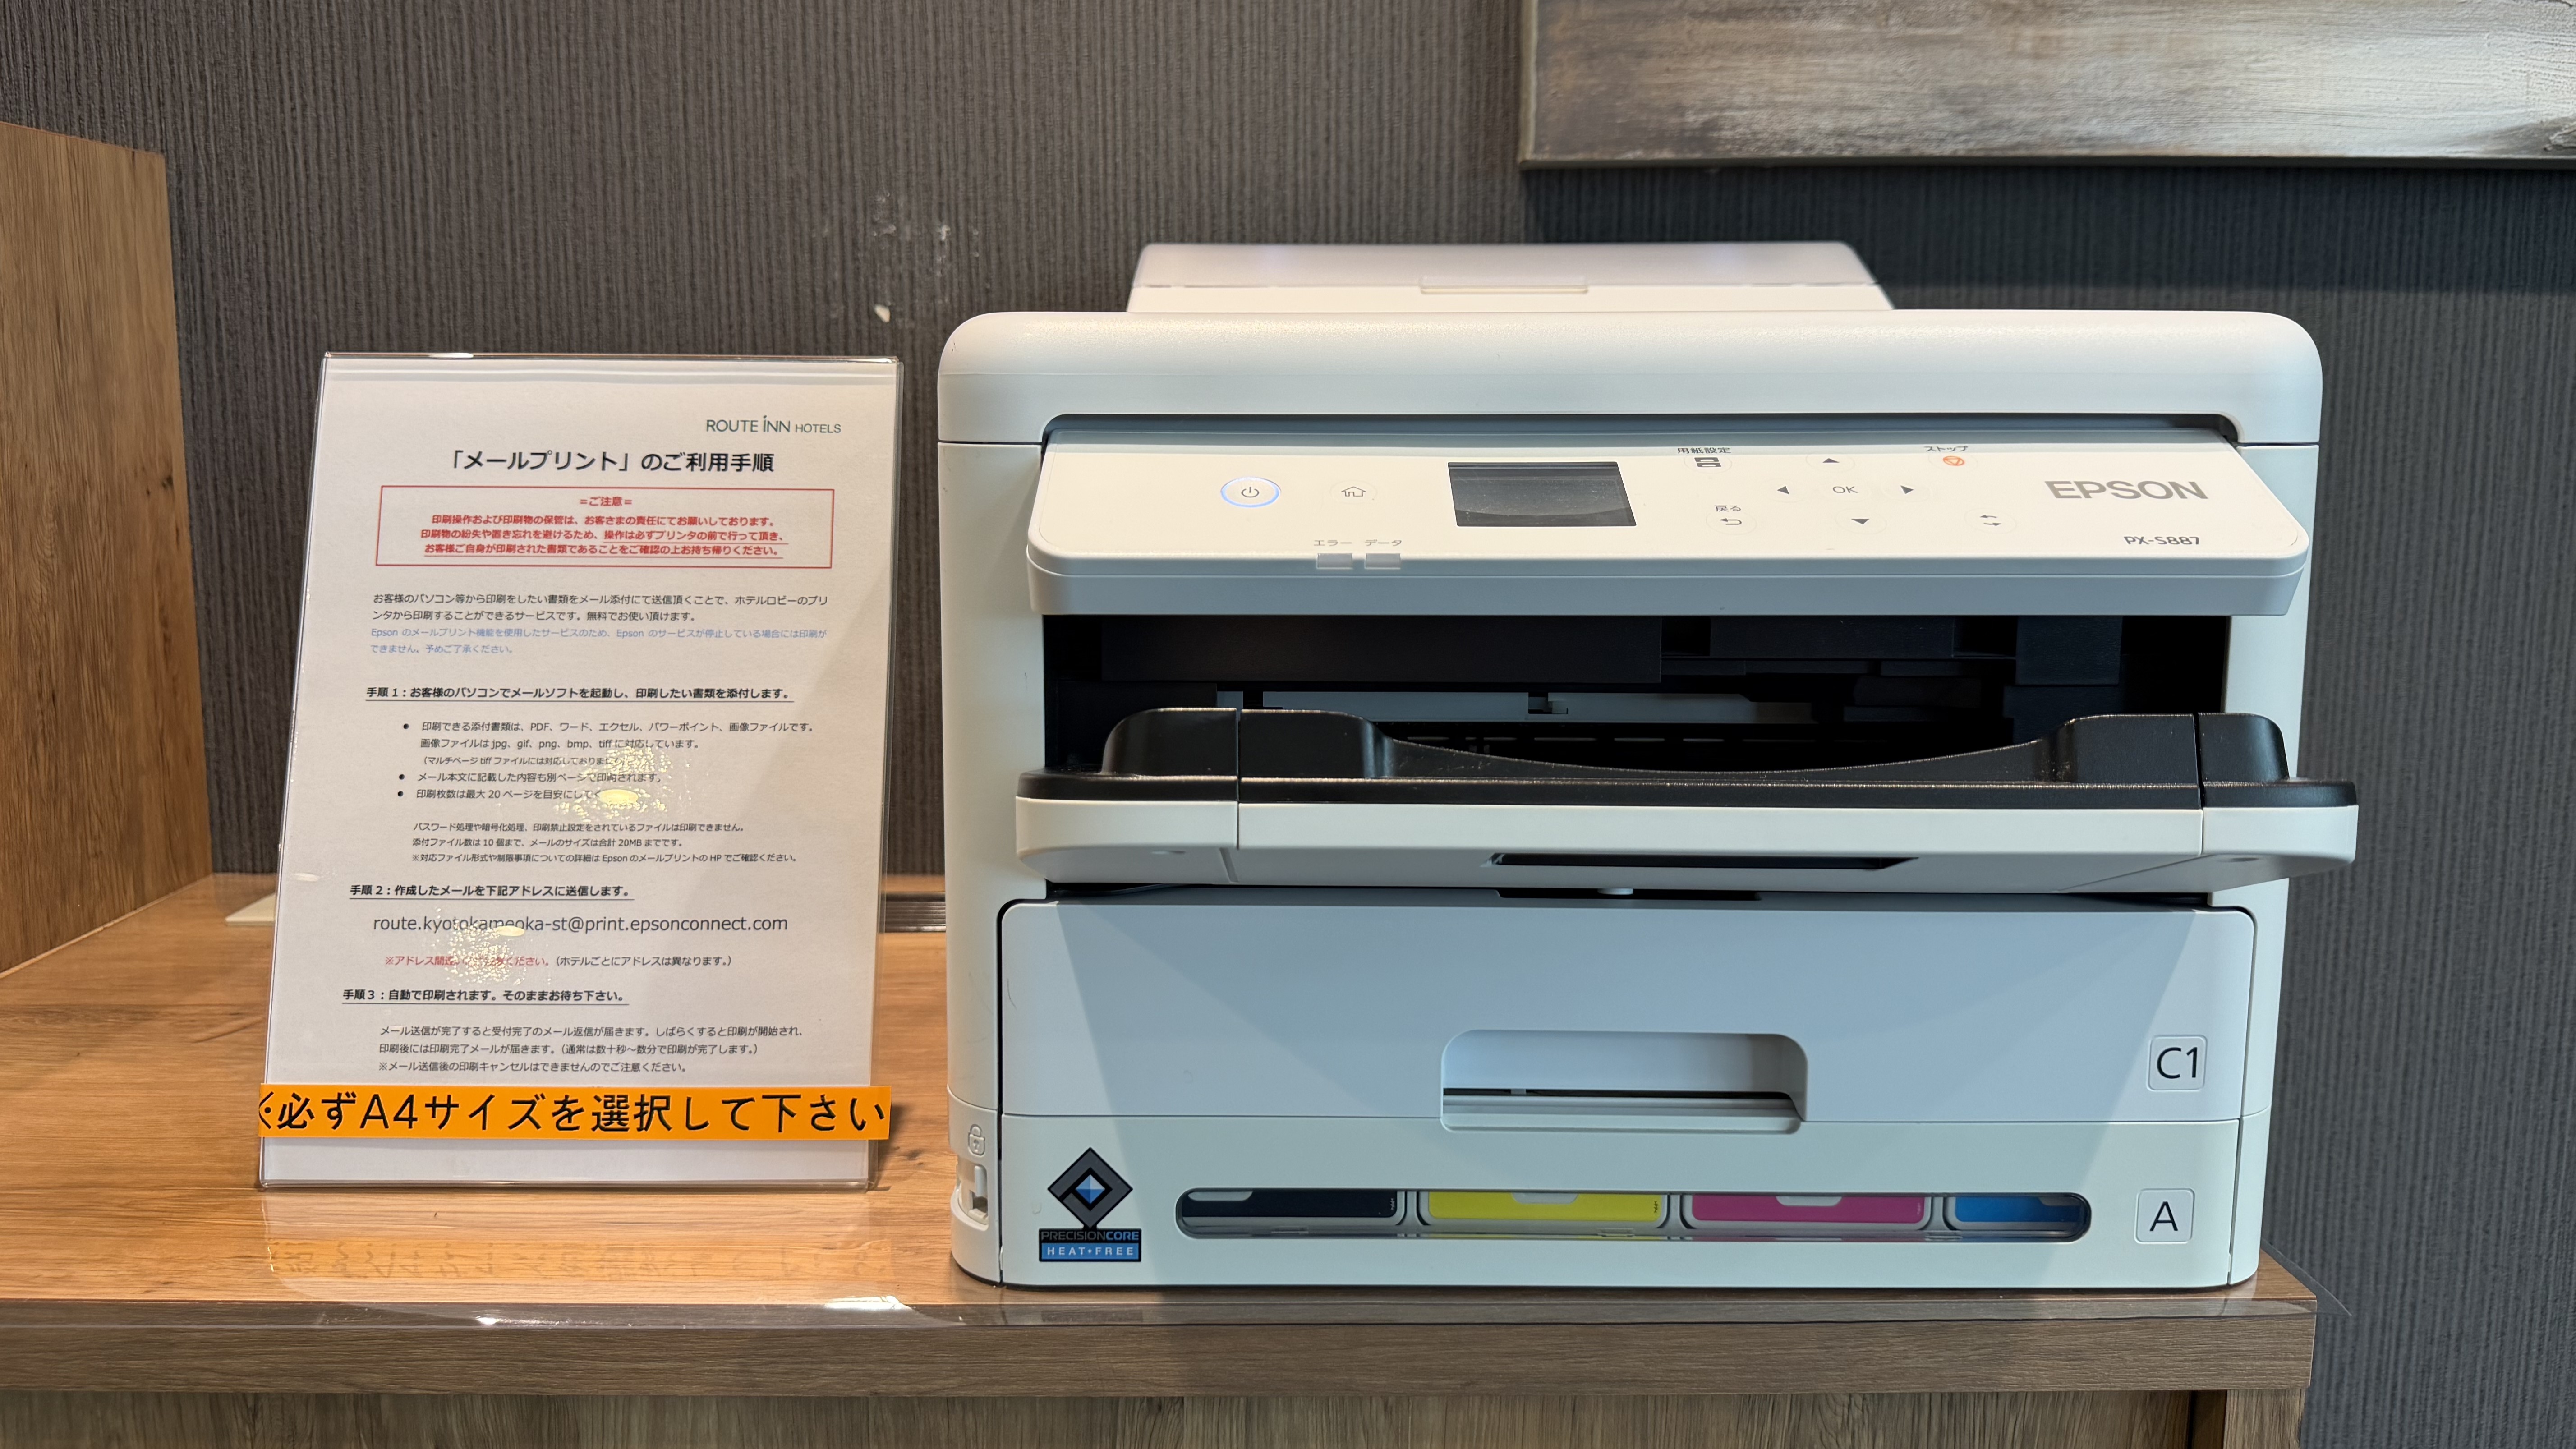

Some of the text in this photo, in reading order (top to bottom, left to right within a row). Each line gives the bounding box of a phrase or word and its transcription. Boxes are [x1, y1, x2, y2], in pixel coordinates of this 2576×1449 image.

[706, 419, 758, 432] ROUTE
[796, 423, 841, 433] HOTELS
[1675, 446, 1734, 455] 用紙設定
[454, 450, 774, 472] 「メールプリント」のご利用手順
[2045, 481, 2208, 499] EPSON
[432, 515, 773, 527] 印刷操作および印刷物の保管は、お客さまの責任にてお願いしております。
[2124, 537, 2199, 545] PX-S887
[424, 544, 777, 555] お客様ご自身が印刷された書類であることをご確認の上お持ち帰りください。
[373, 611, 694, 621] ンタから印刷することができるサービスです。無料でお使い頂けます。
[372, 629, 398, 637] Epson
[370, 644, 512, 653] できません。予めご了承ください。
[373, 916, 788, 934] route.kyotokameoka-st@print.epsonconnect.com
[2157, 1047, 2197, 1079] C1
[2150, 1201, 2178, 1231] A
[1041, 1231, 1139, 1241] PRECISIONCORE
